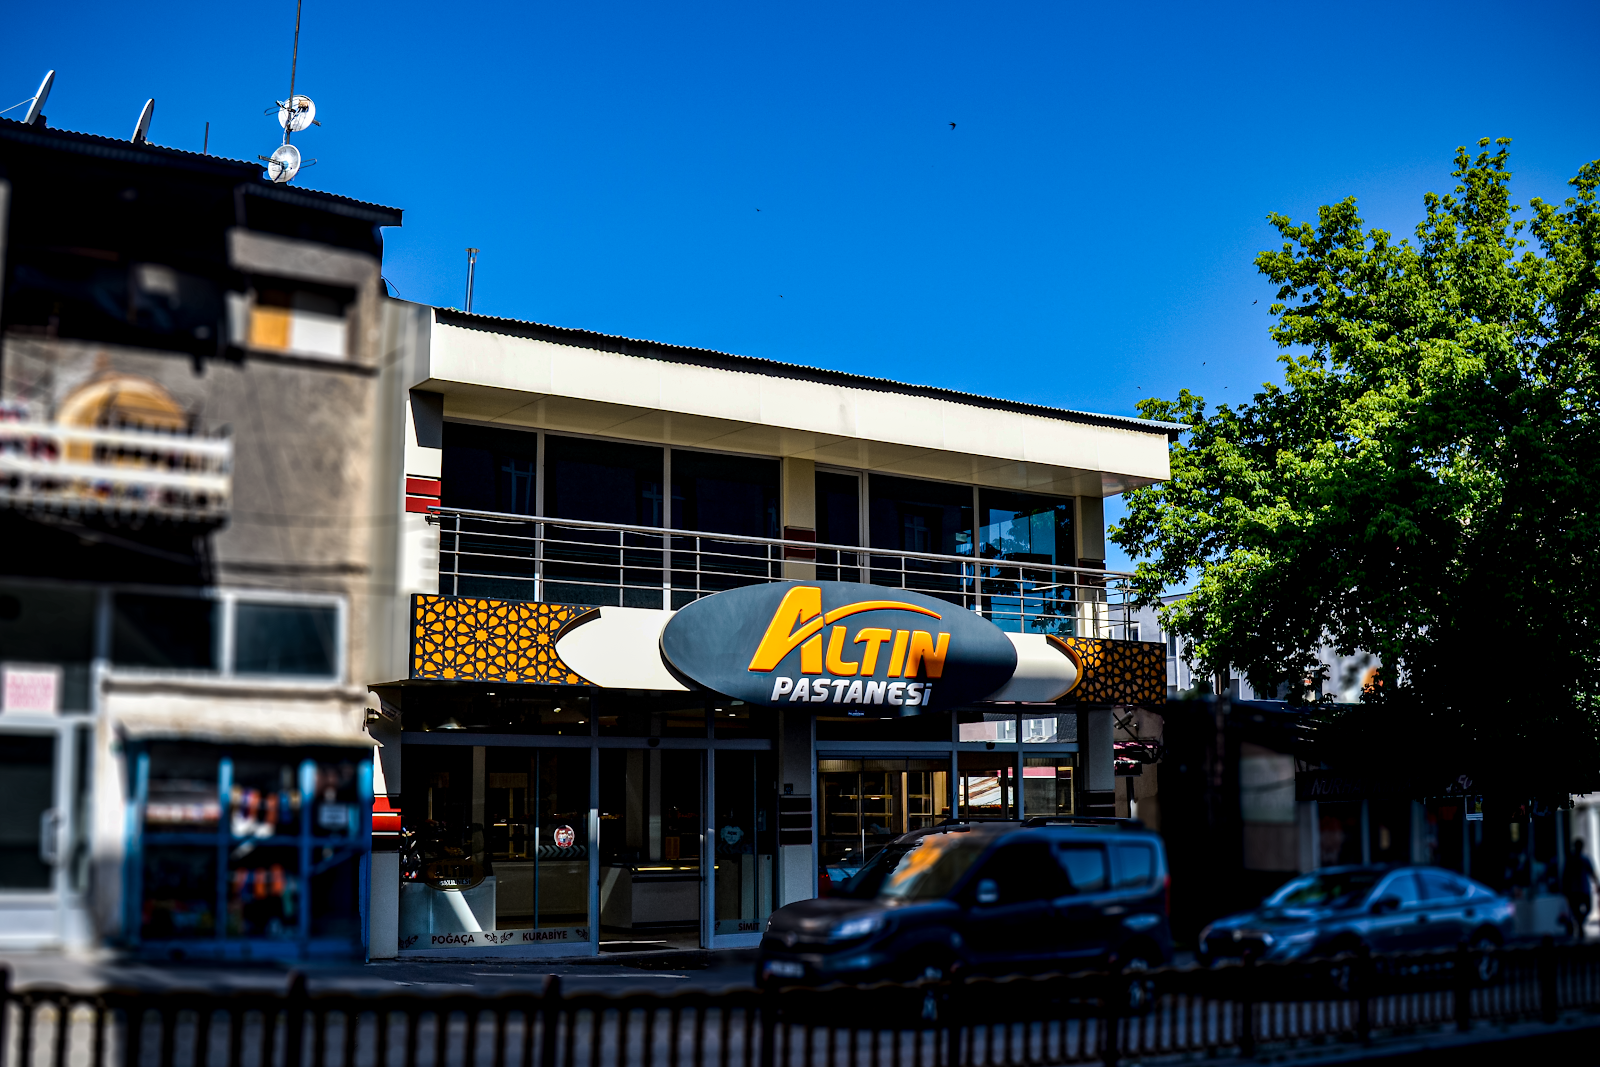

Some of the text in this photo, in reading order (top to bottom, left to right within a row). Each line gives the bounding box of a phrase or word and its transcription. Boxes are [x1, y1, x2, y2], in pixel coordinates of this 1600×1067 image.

[748, 586, 950, 678] ALTIN
[771, 677, 932, 706] PASTANESİ
[431, 929, 568, 946] POĞAÇA KURABİYE
